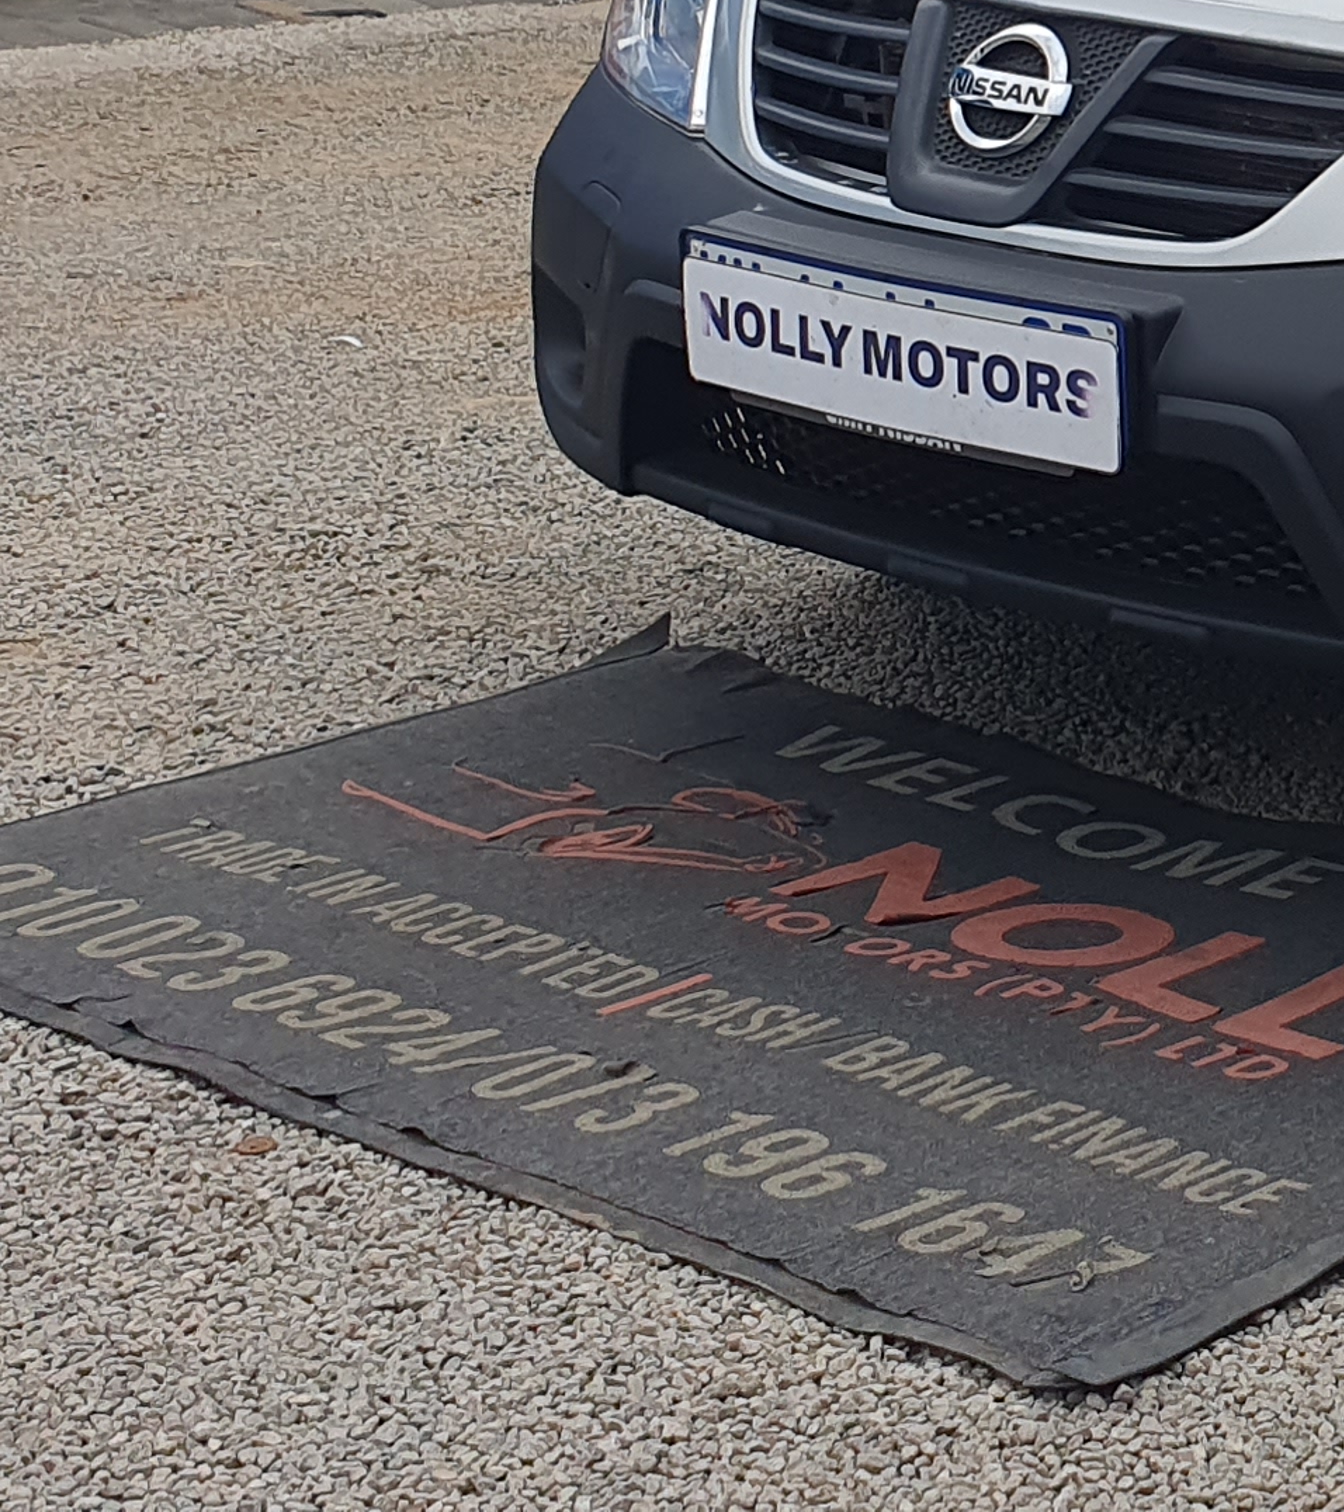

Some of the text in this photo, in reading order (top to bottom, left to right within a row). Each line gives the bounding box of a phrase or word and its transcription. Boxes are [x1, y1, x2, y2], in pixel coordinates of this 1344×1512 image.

[951, 68, 1050, 108] NISSAN
[699, 291, 1099, 419] NOLLY MOTORS
[723, 895, 991, 980] MOORS
[139, 818, 341, 883] TRADE
[992, 1100, 1312, 1215] FINANCE
[662, 1111, 888, 1200] 196
